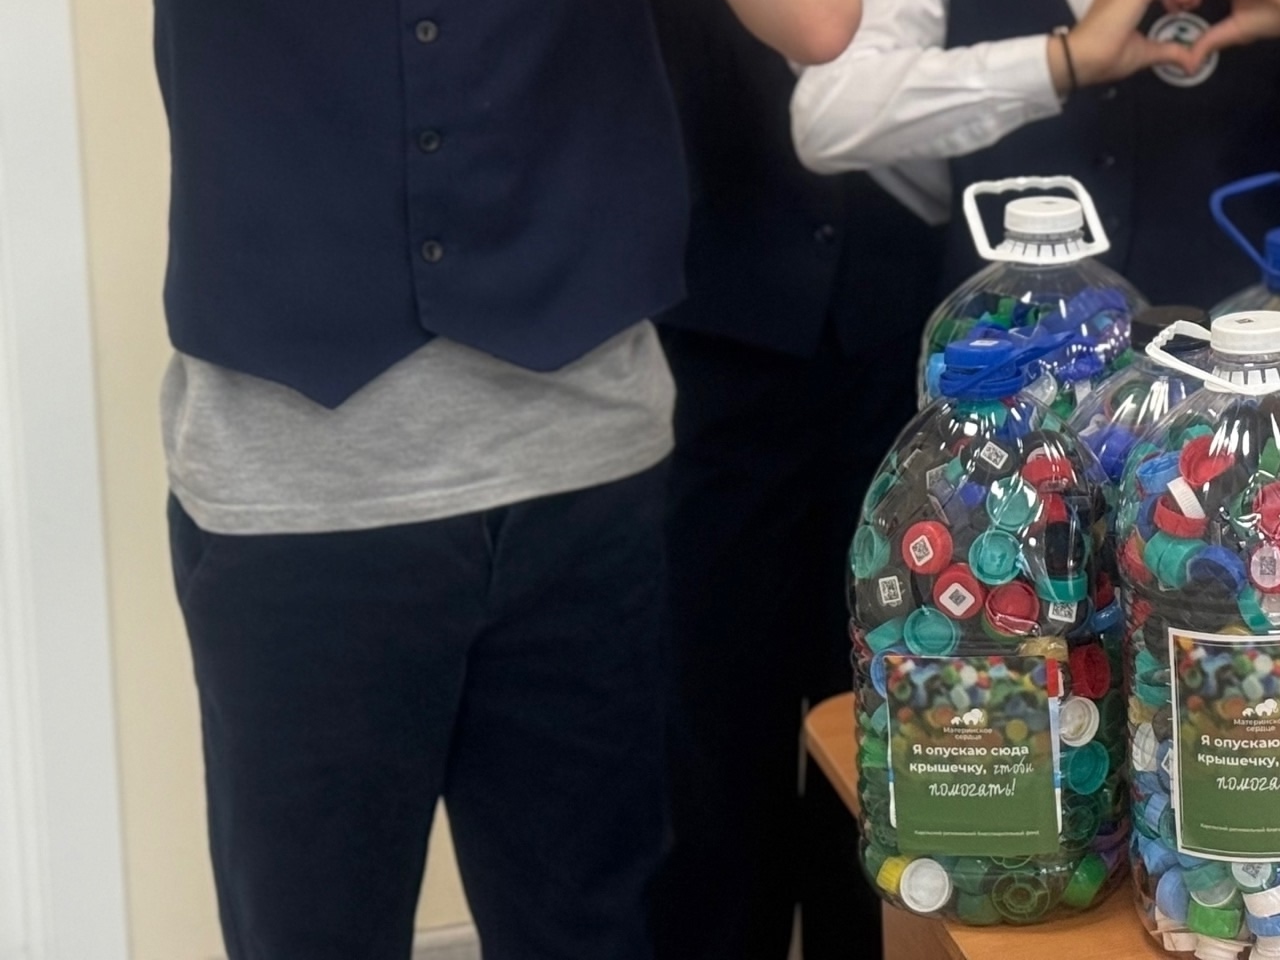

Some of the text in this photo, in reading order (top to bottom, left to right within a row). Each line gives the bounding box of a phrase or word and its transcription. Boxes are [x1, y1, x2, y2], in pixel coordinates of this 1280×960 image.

[1201, 735, 1211, 745] Я
[1214, 737, 1280, 750] опускаю
[912, 744, 1029, 758] Я опускаю сюда
[1197, 753, 1280, 768] крышечку,
[909, 763, 987, 775] крышечку,
[929, 778, 1016, 796] помогать!
